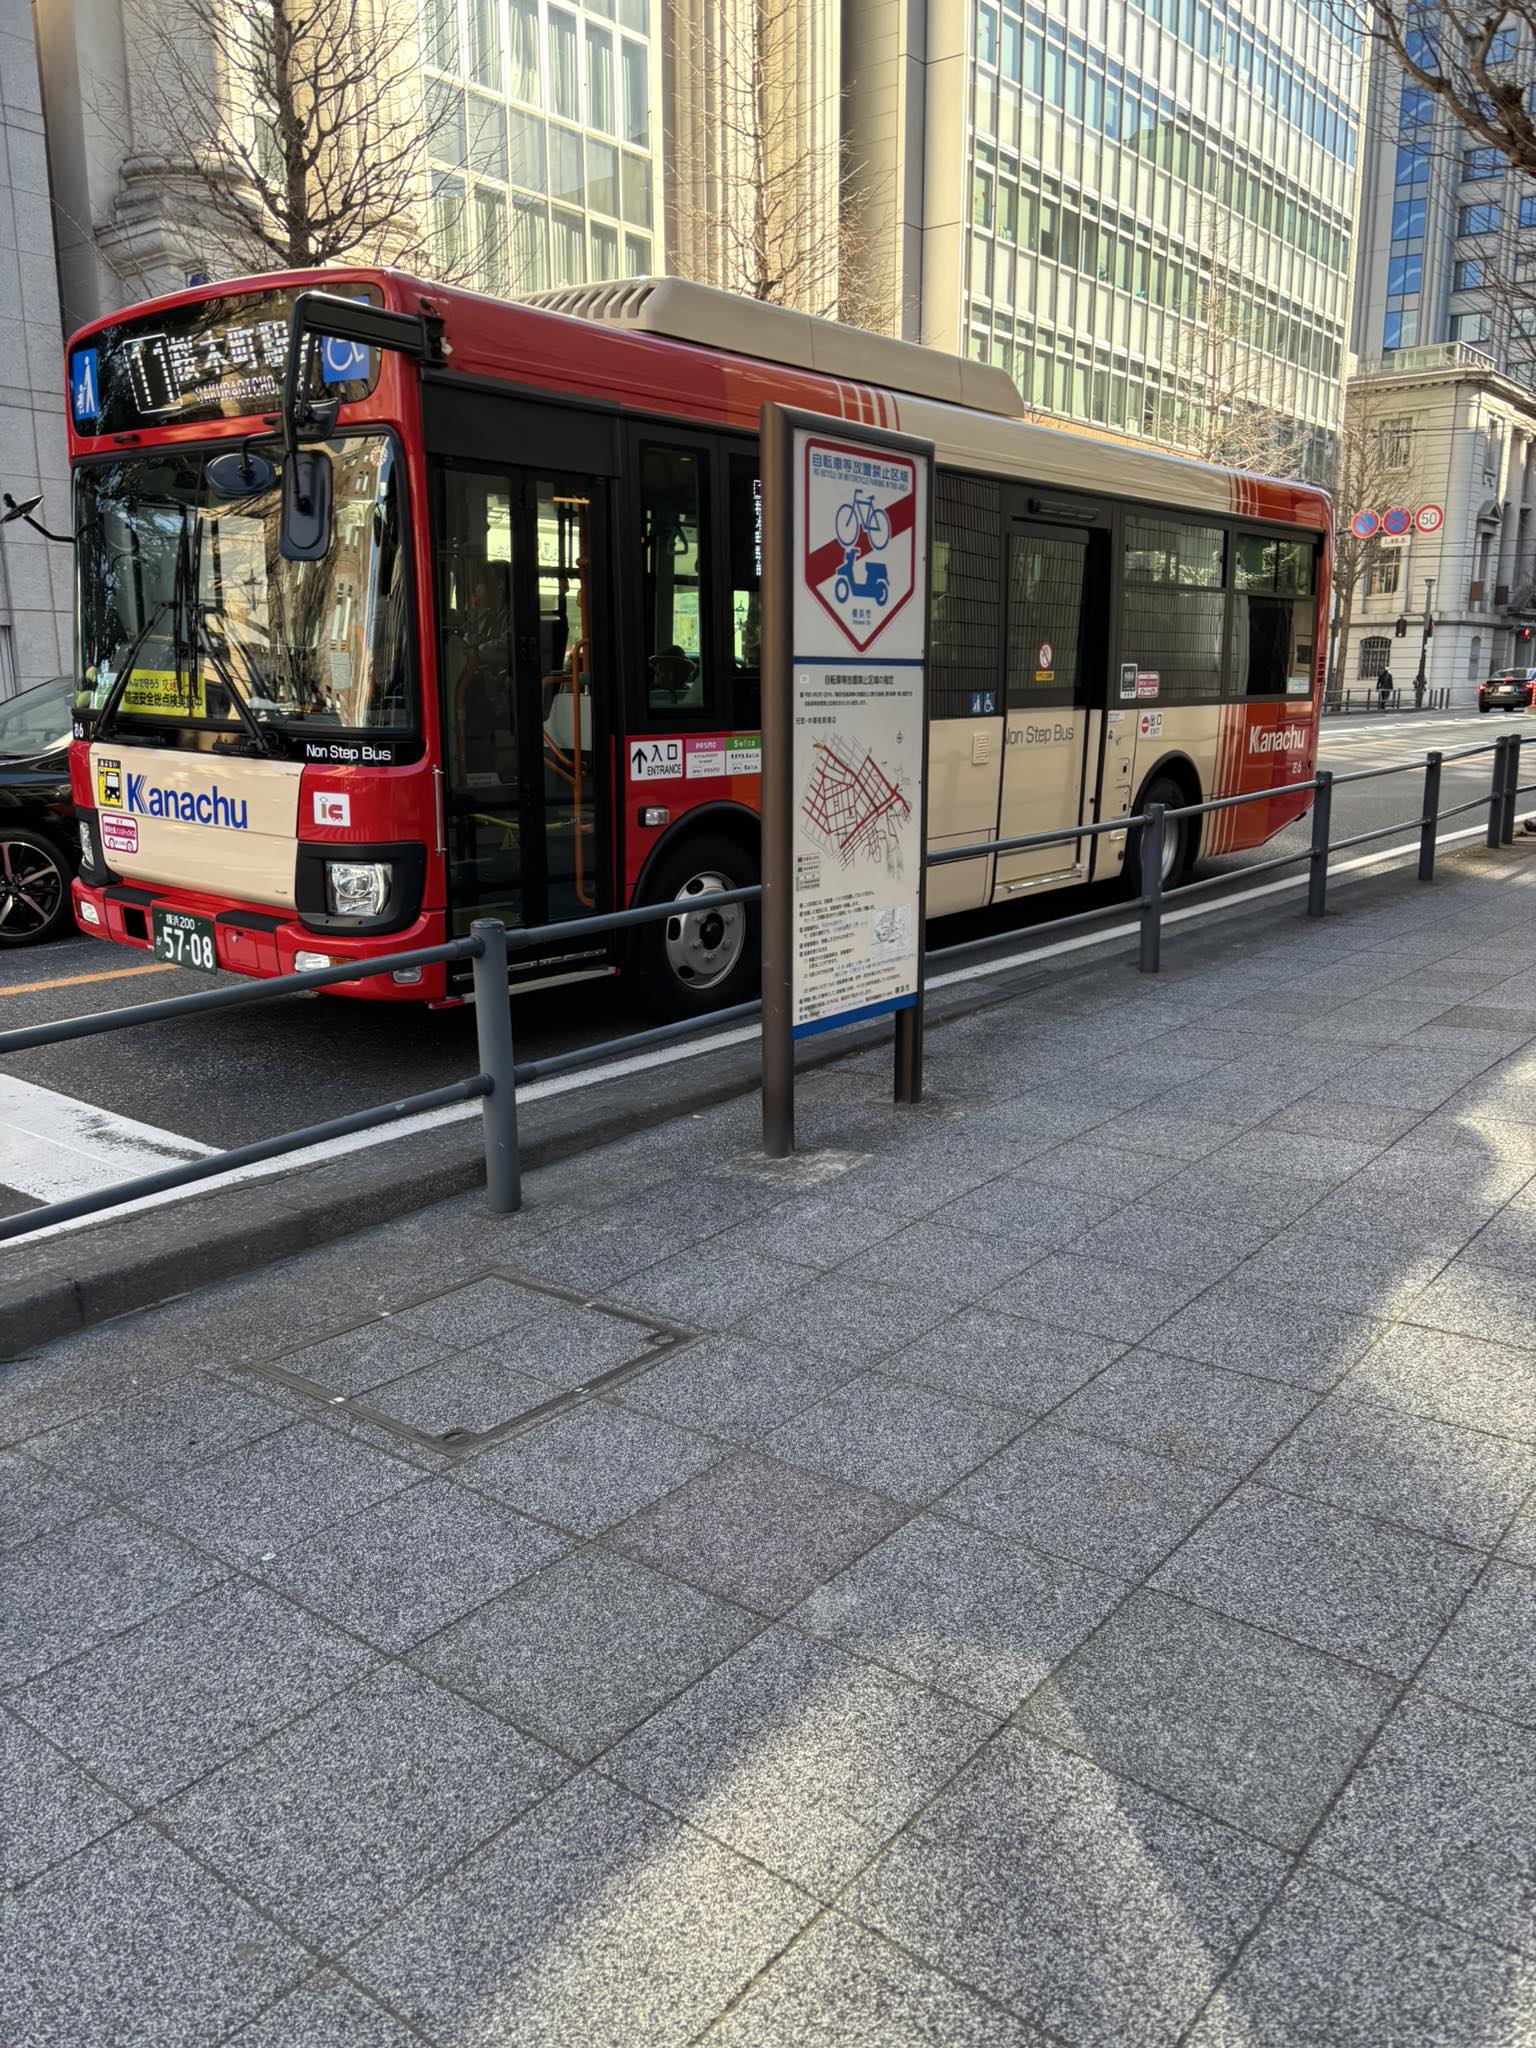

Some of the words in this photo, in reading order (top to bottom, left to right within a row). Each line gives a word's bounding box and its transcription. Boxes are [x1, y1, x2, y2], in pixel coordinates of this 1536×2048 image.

[812, 453, 909, 482] 自転車等放置禁止区域
[1421, 512, 1438, 526] 50
[1026, 725, 1051, 744] Step
[1054, 723, 1074, 742] Bus
[1249, 723, 1306, 754] Kanachu
[306, 743, 327, 757] Non
[329, 745, 359, 761] Step
[362, 746, 392, 761] Bus
[695, 741, 717, 750] PASMO
[733, 739, 756, 748] Suica
[651, 744, 678, 762] 入口
[647, 763, 682, 777] ENTRANCE
[127, 772, 248, 829] Kanachu
[163, 926, 214, 969] 57-08
